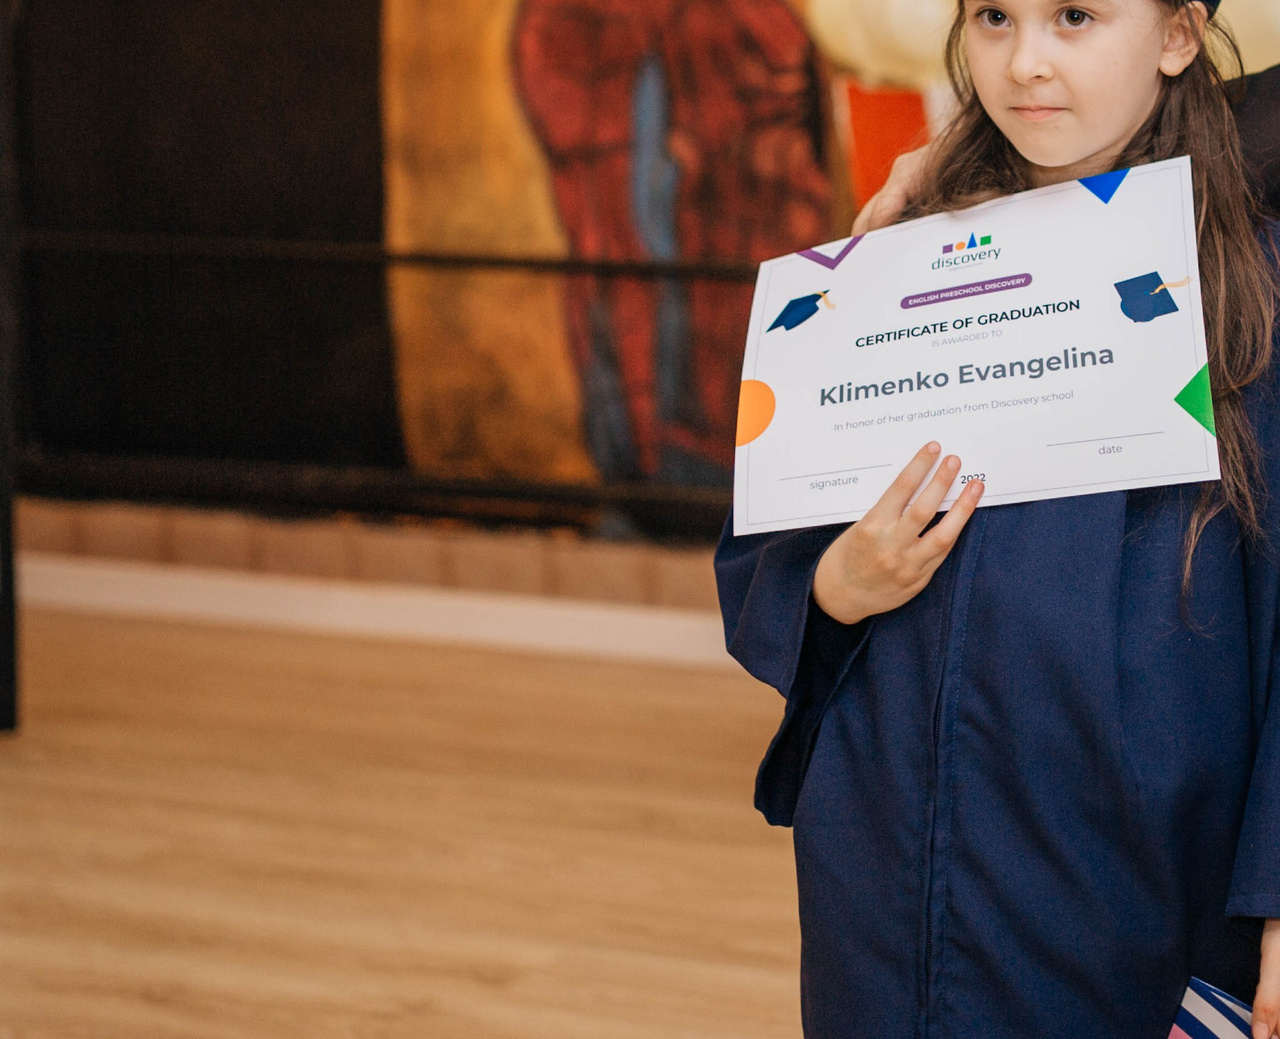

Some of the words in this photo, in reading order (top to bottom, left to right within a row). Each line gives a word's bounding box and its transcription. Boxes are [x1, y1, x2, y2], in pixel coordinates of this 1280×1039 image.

[930, 247, 1002, 270] discovery
[908, 294, 939, 306] ENGLISH
[939, 285, 984, 300] PRESCHOOL
[984, 276, 1027, 291] DISCOVERY
[855, 321, 949, 348] CERTIFICATE
[952, 316, 975, 330] OF
[977, 299, 1081, 326] GRADUATION
[931, 340, 940, 348] IS
[941, 331, 989, 346] AWARDED
[991, 329, 1003, 338] TO
[819, 370, 950, 407] Klimenko
[958, 345, 1115, 385] Evangelina
[833, 422, 844, 431] In
[845, 417, 875, 430] honor
[877, 415, 887, 425] of
[888, 413, 905, 424] her
[906, 404, 962, 424] graduation
[963, 401, 989, 413] from
[991, 395, 1039, 410] Discovery
[1041, 390, 1075, 403] school
[1098, 445, 1123, 455] date
[809, 475, 859, 491] signature
